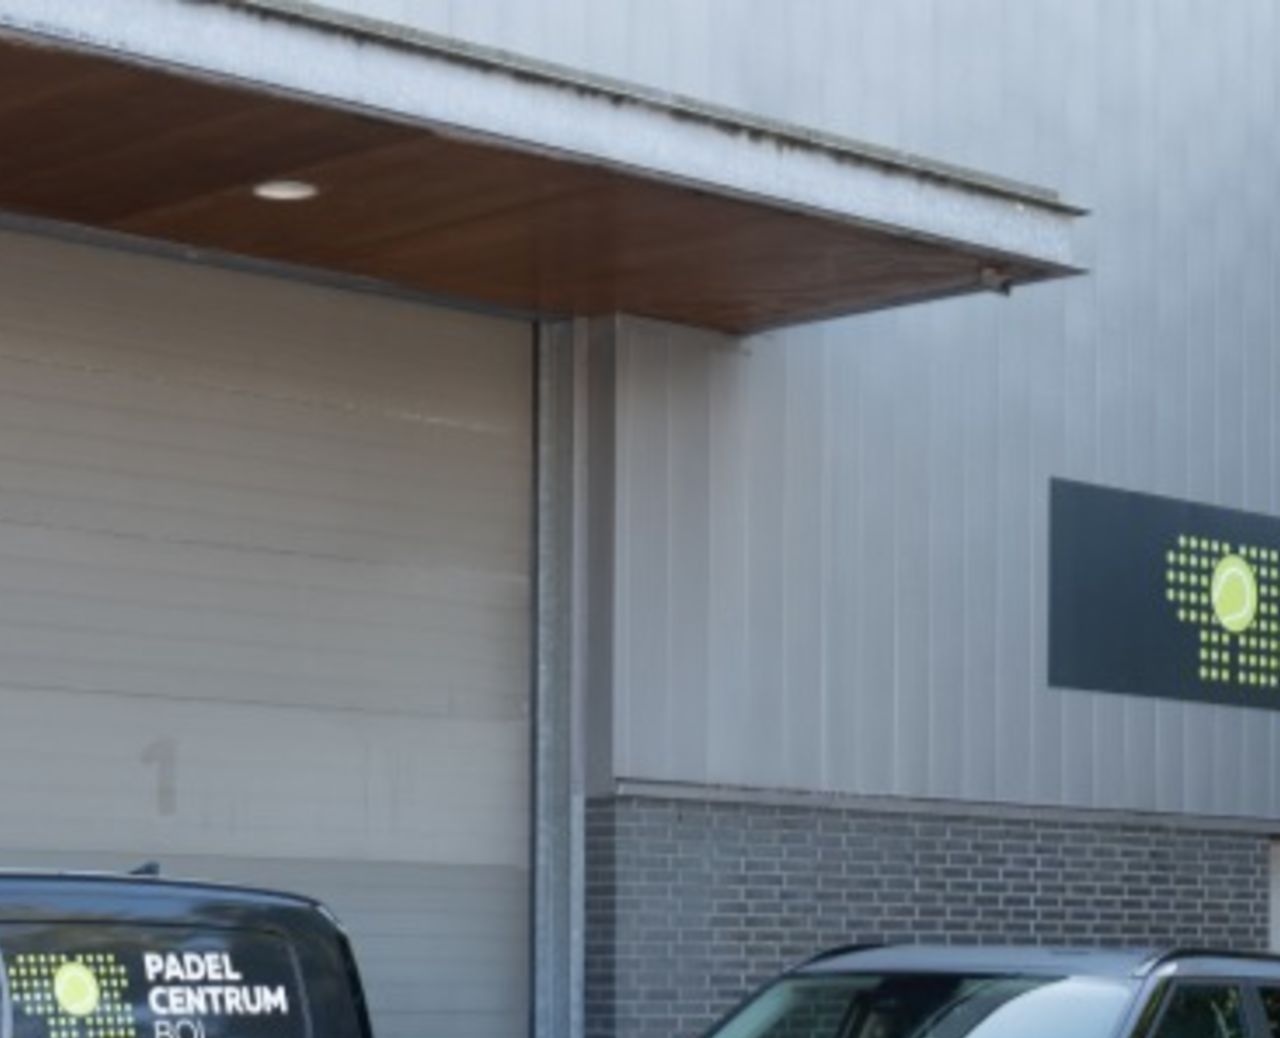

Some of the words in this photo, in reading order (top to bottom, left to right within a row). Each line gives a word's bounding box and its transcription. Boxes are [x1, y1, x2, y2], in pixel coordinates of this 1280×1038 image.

[140, 737, 178, 817] 1
[143, 952, 243, 981] PADEL
[148, 985, 289, 1016] CENTRUM
